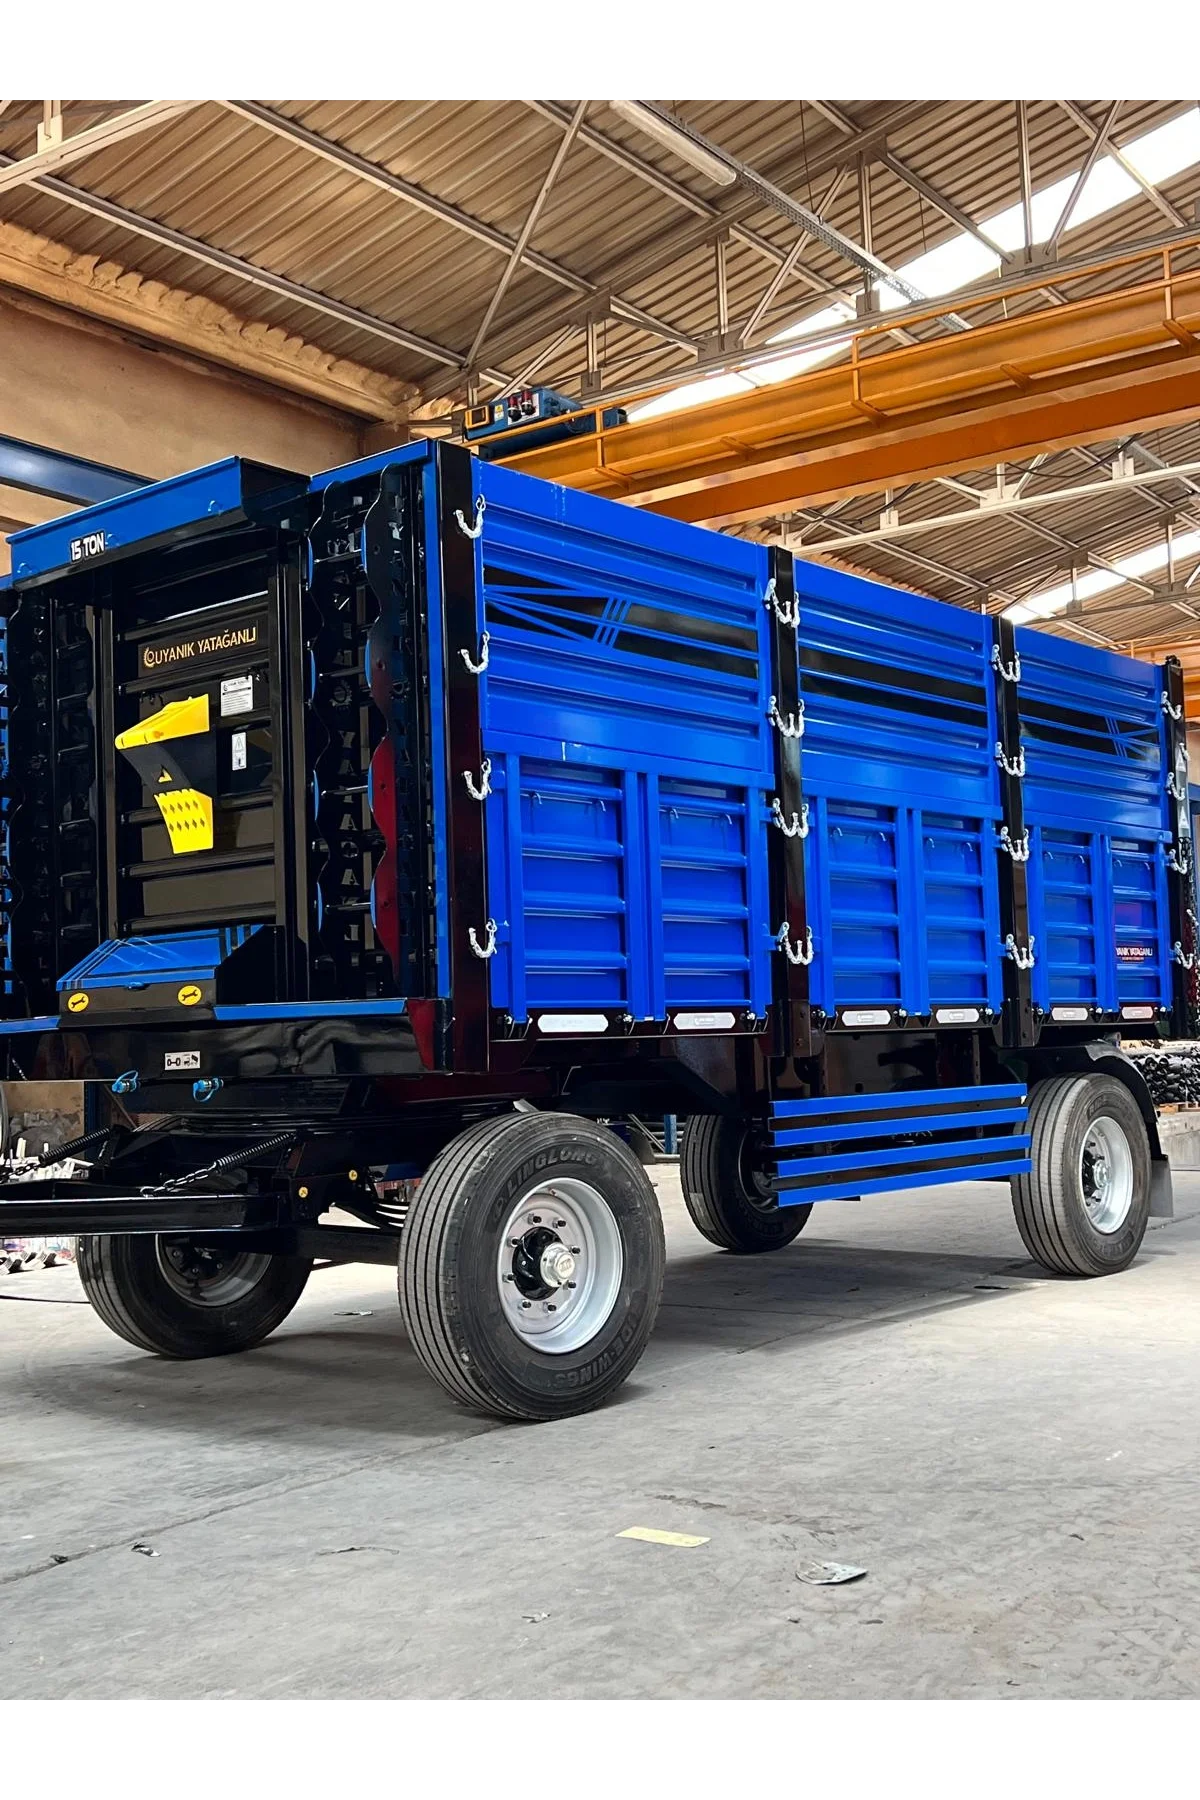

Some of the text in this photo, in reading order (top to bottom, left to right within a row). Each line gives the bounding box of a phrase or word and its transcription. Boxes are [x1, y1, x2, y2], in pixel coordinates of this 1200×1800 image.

[70, 532, 105, 561] 15 TON
[154, 626, 257, 665] UYANIK YATAĞANLI
